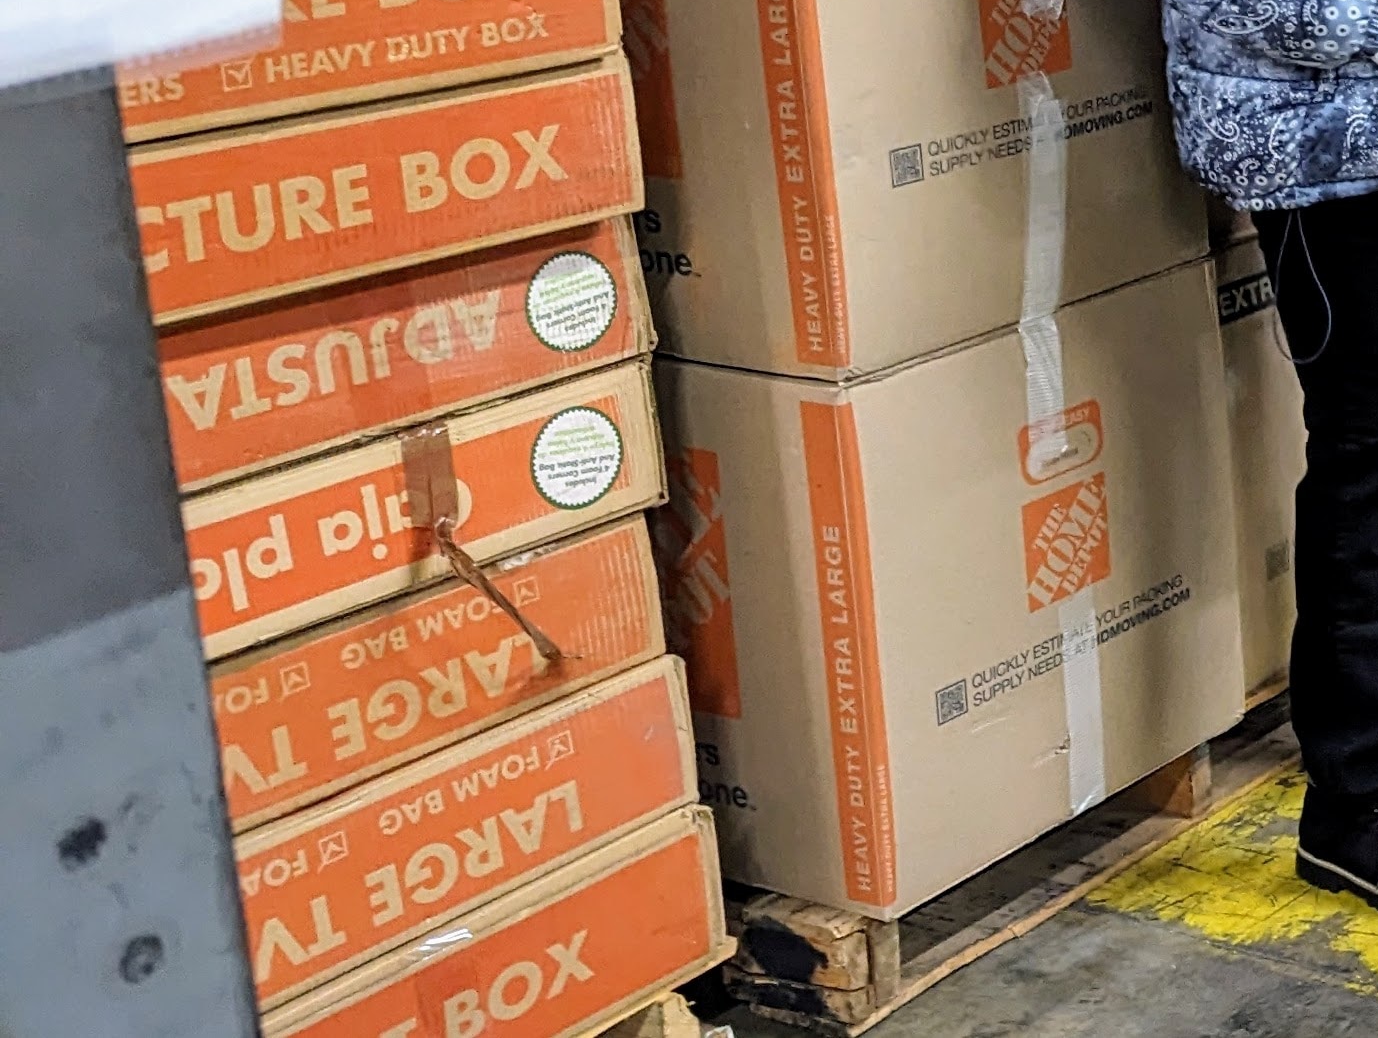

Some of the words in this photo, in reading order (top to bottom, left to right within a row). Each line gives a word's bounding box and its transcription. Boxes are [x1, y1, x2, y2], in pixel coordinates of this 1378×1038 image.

[265, 39, 376, 83] HEAVY
[385, 26, 470, 63] DUTY
[481, 12, 550, 48] BOX
[777, 78, 804, 184] EXTRA
[927, 129, 989, 157] QUICKLY
[929, 152, 983, 176] SUPPLY
[989, 136, 1033, 159] NEEDS
[400, 124, 569, 214] BOX
[792, 196, 815, 261] DUTY
[802, 270, 824, 352] HEAVY
[166, 291, 500, 431] ADJUSTA
[538, 463, 555, 471] Bag
[565, 476, 597, 488] Includes
[599, 454, 615, 463] And
[1027, 477, 1106, 606] HOME
[1033, 502, 1067, 551] THE
[822, 525, 849, 624] LARGE
[341, 626, 410, 669] BAG
[971, 649, 1030, 689] QUICKLY
[1095, 601, 1131, 627] YOUR
[1133, 574, 1183, 610] PACKING
[327, 631, 550, 762] LARGE
[833, 637, 859, 734] EXTRA
[973, 670, 1026, 707] SUPPLY
[450, 746, 540, 802] FOAM
[845, 746, 865, 807] DUTY
[378, 788, 445, 835] BAG
[364, 779, 585, 928] LARGE
[851, 817, 872, 892] HEAVY
[254, 894, 347, 984] TV
[443, 928, 596, 1038] BOX
